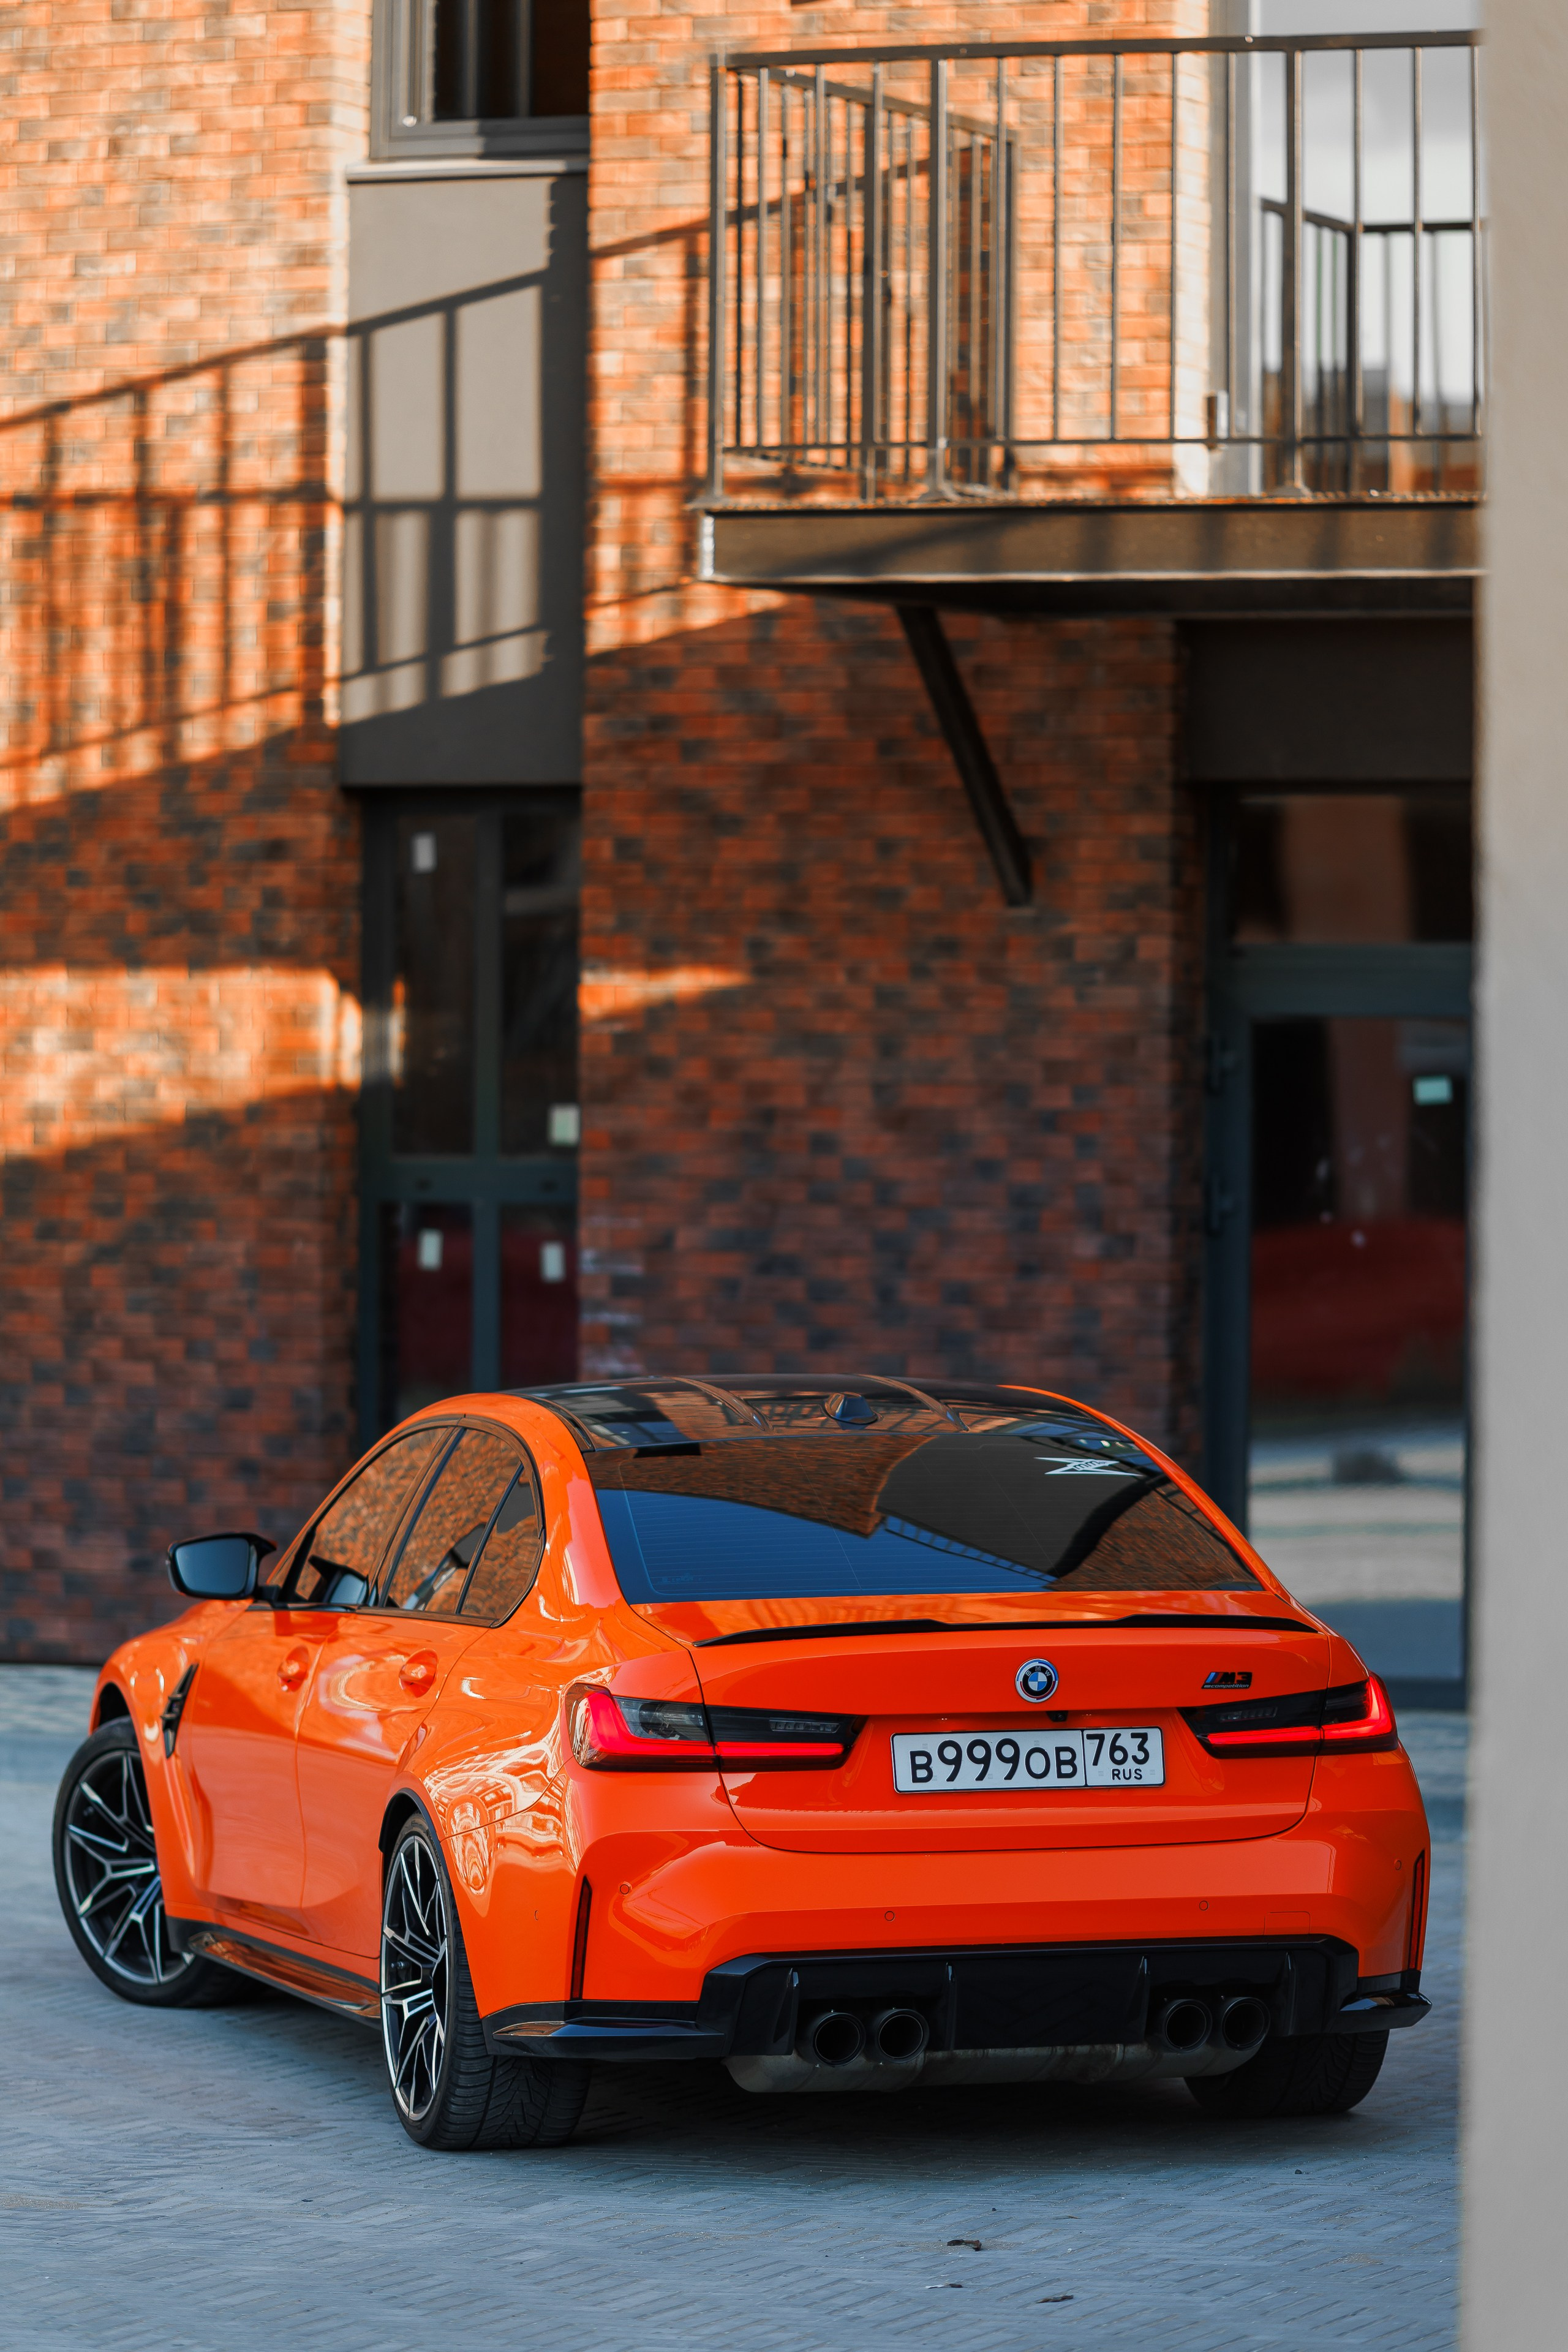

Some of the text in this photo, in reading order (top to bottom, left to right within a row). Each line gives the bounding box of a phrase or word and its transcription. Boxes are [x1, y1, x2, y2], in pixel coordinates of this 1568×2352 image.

[1025, 1666, 1051, 1677] BMW
[1217, 1672, 1253, 1684] M3
[1085, 1732, 1150, 1766] 763
[1111, 1768, 1143, 1781] RUS
